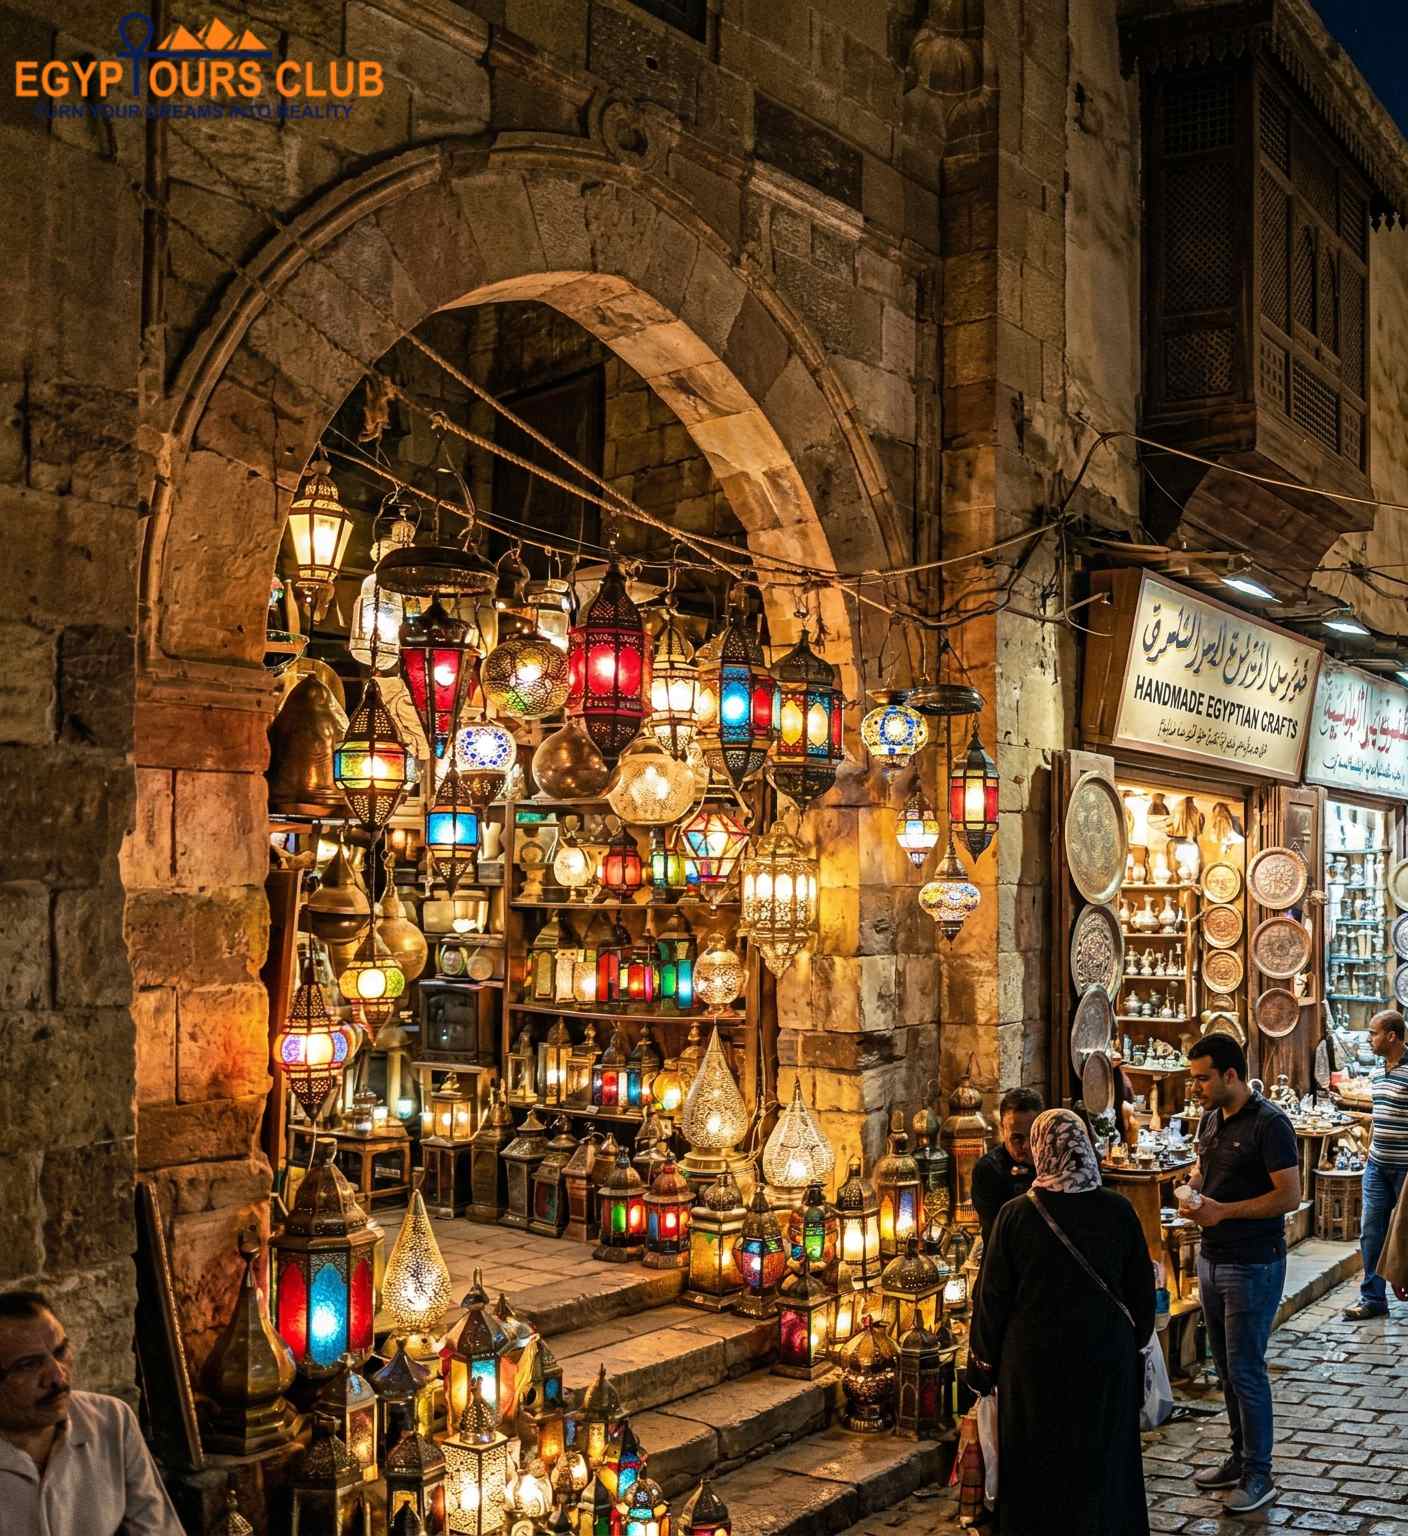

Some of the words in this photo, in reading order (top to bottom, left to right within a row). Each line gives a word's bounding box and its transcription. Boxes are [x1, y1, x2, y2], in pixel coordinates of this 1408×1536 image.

[1134, 674, 1204, 716] HANDMADE
[1205, 695, 1260, 730] EGYPTIAN
[1261, 711, 1299, 740] CRAFTS
